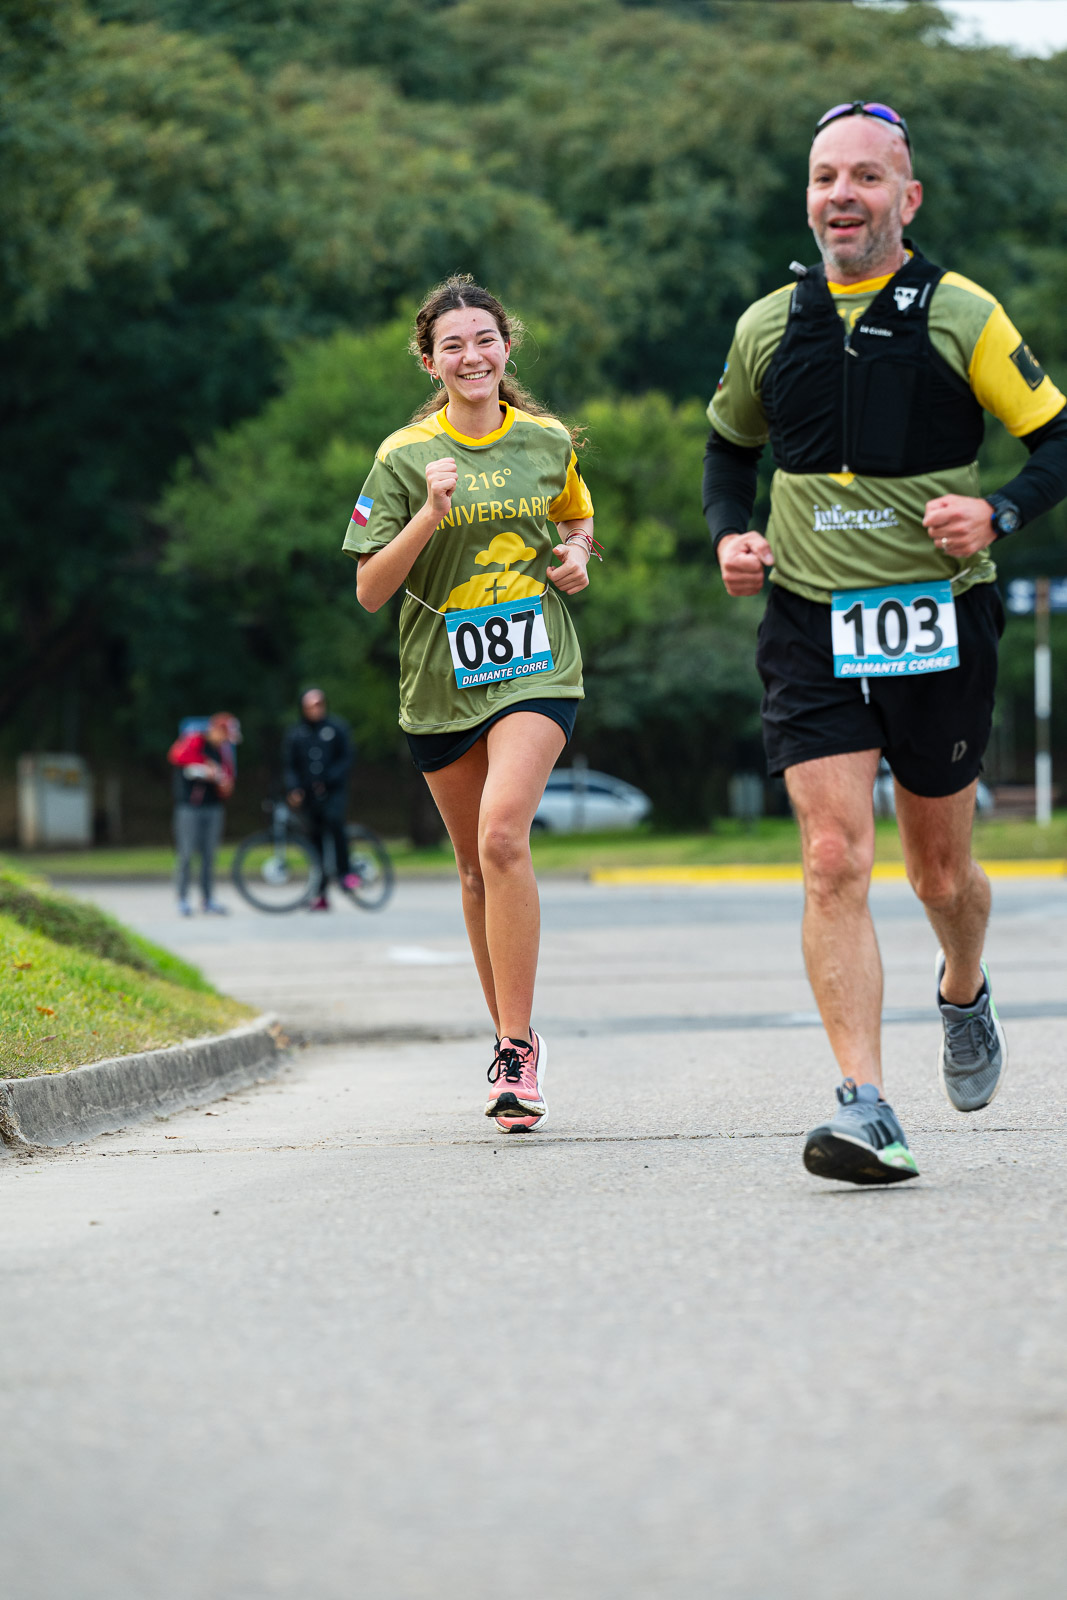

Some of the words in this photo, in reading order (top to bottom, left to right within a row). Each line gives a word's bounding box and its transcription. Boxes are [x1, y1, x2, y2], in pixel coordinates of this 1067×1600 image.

[464, 468, 512, 491] 216°
[436, 496, 552, 531] NIVERSARIO
[456, 609, 535, 671] 087
[843, 596, 943, 659] 103
[462, 667, 513, 685] DIAMANTE
[515, 660, 548, 675] CORRE
[840, 660, 907, 674] DIAMANTE
[908, 655, 952, 671] CORRE
